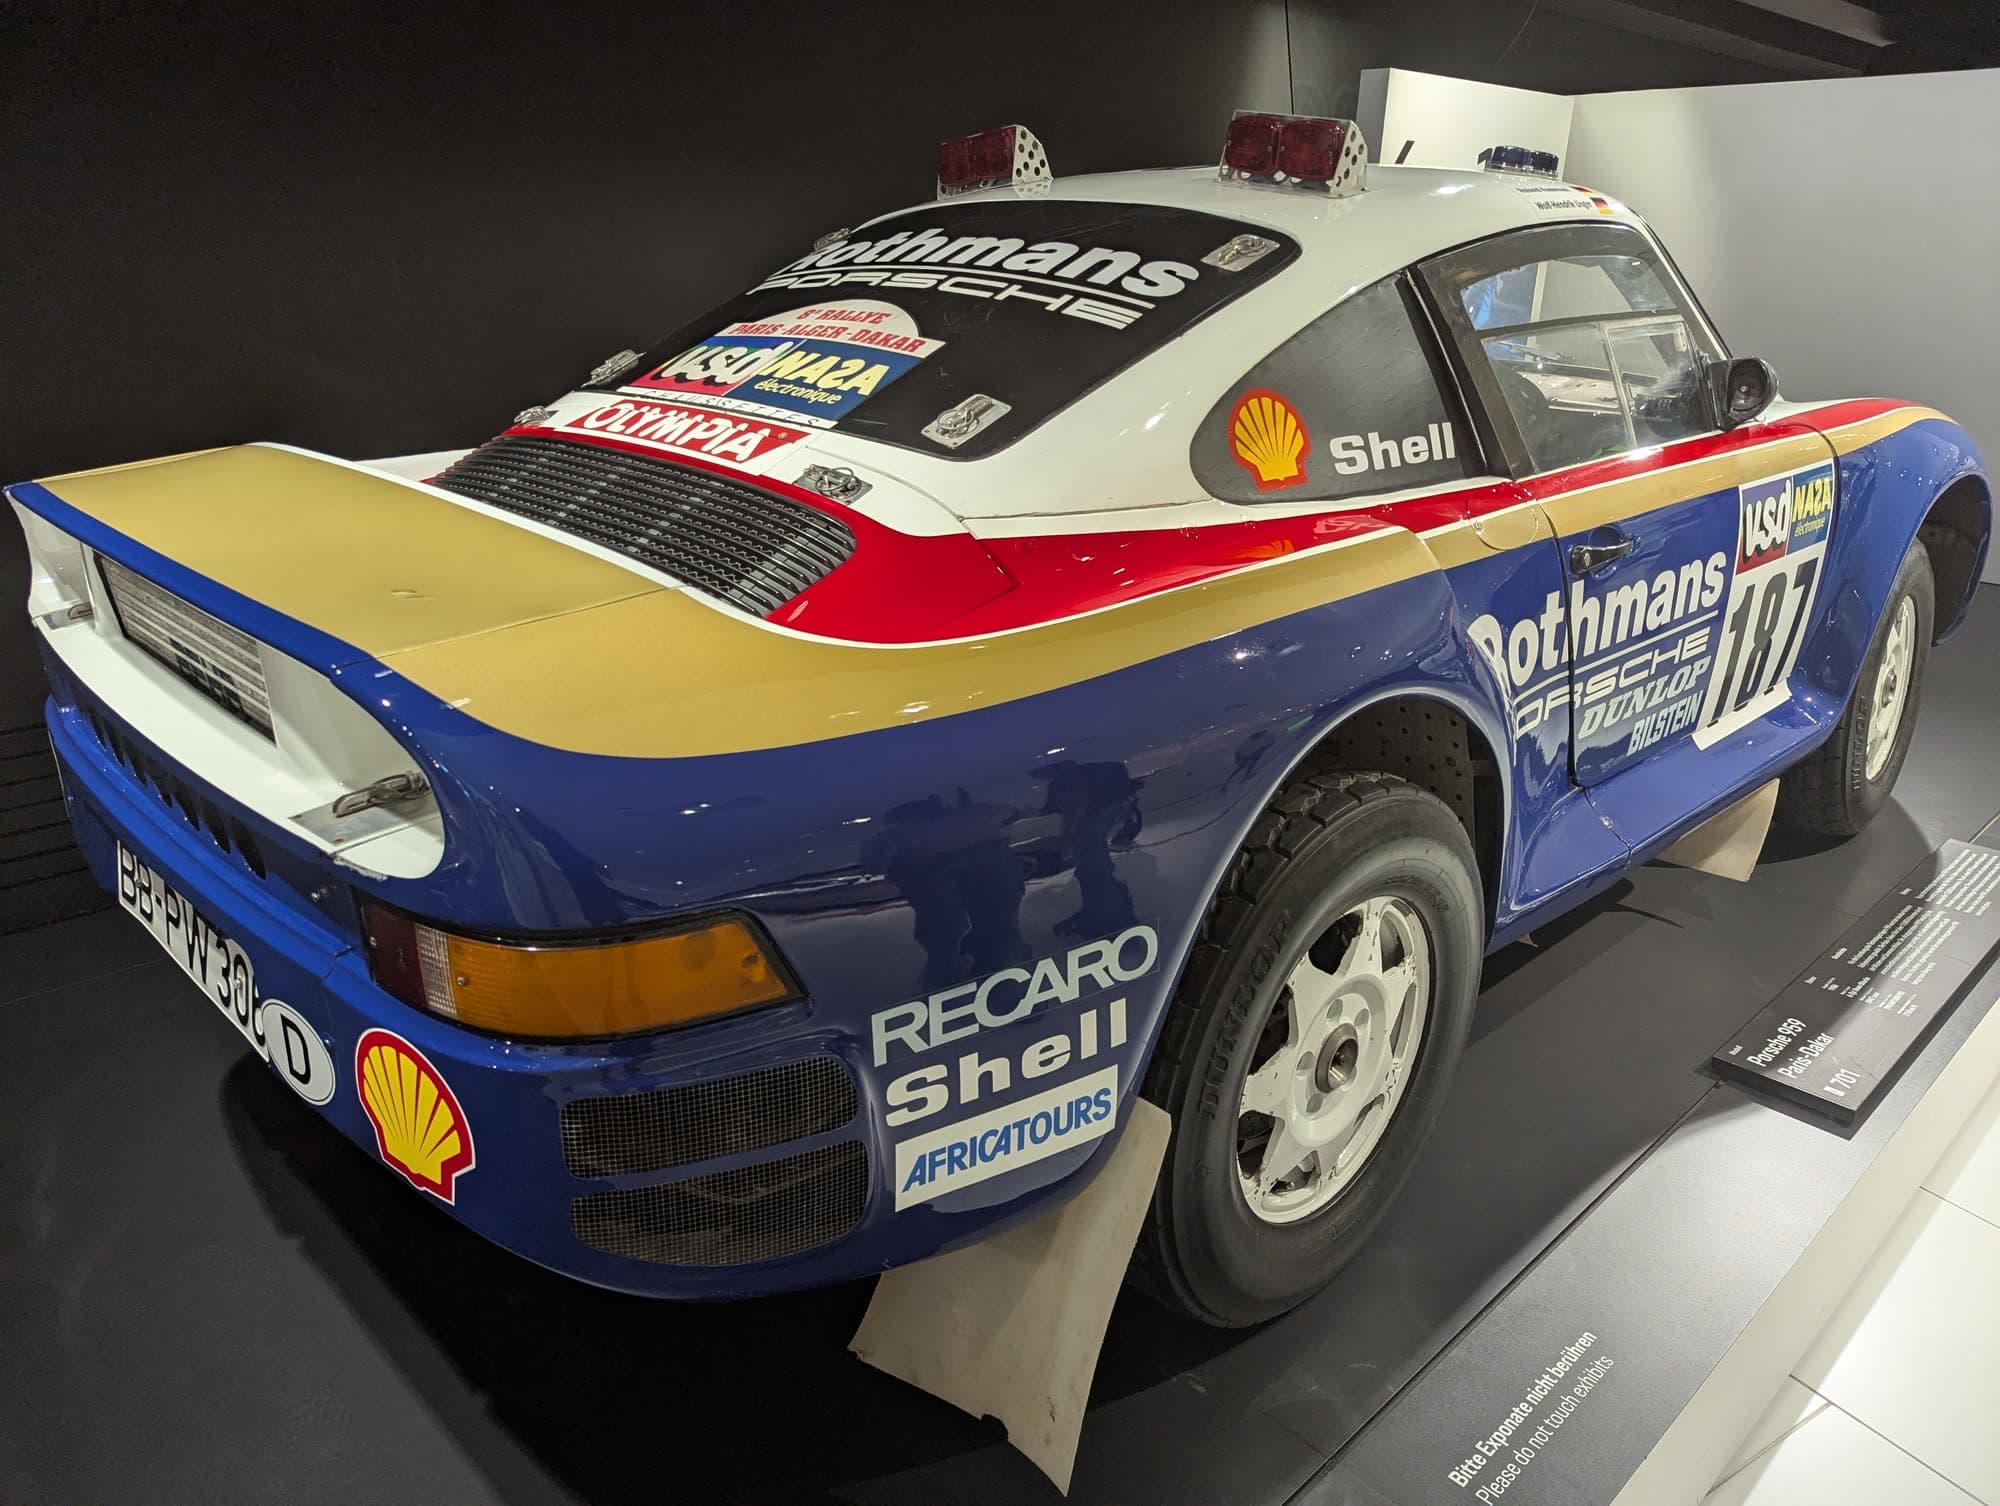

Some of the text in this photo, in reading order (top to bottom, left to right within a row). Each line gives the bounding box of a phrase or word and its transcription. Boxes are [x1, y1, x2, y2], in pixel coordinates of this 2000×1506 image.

[768, 228, 1199, 297] Rothmans
[745, 271, 1144, 330] PORSCHE
[817, 309, 892, 325] RALLYE
[753, 378, 846, 405] électronique
[583, 401, 772, 462] OLYMPIA
[1329, 421, 1456, 475] Shell
[1467, 551, 1727, 713] Rothmans
[1706, 554, 1820, 728] 187
[1514, 626, 1710, 741] ORSCHE
[1578, 655, 1712, 741] DUNLOP
[1626, 689, 1705, 757] BILSTEIN
[871, 925, 1158, 1068] RECARO
[280, 1012, 311, 1085] D
[886, 997, 1127, 1127] Shell
[1746, 1017, 1807, 1068] Porsche 959
[1777, 1032, 1835, 1079] Paris-Dakar
[1830, 1068, 1861, 1089] 701
[902, 1087, 1112, 1194] AFRICATOURS
[1448, 1331, 1598, 1488] Bitte Exponate nicht berühren
[1475, 1355, 1614, 1506] Please do not touch exhibits
